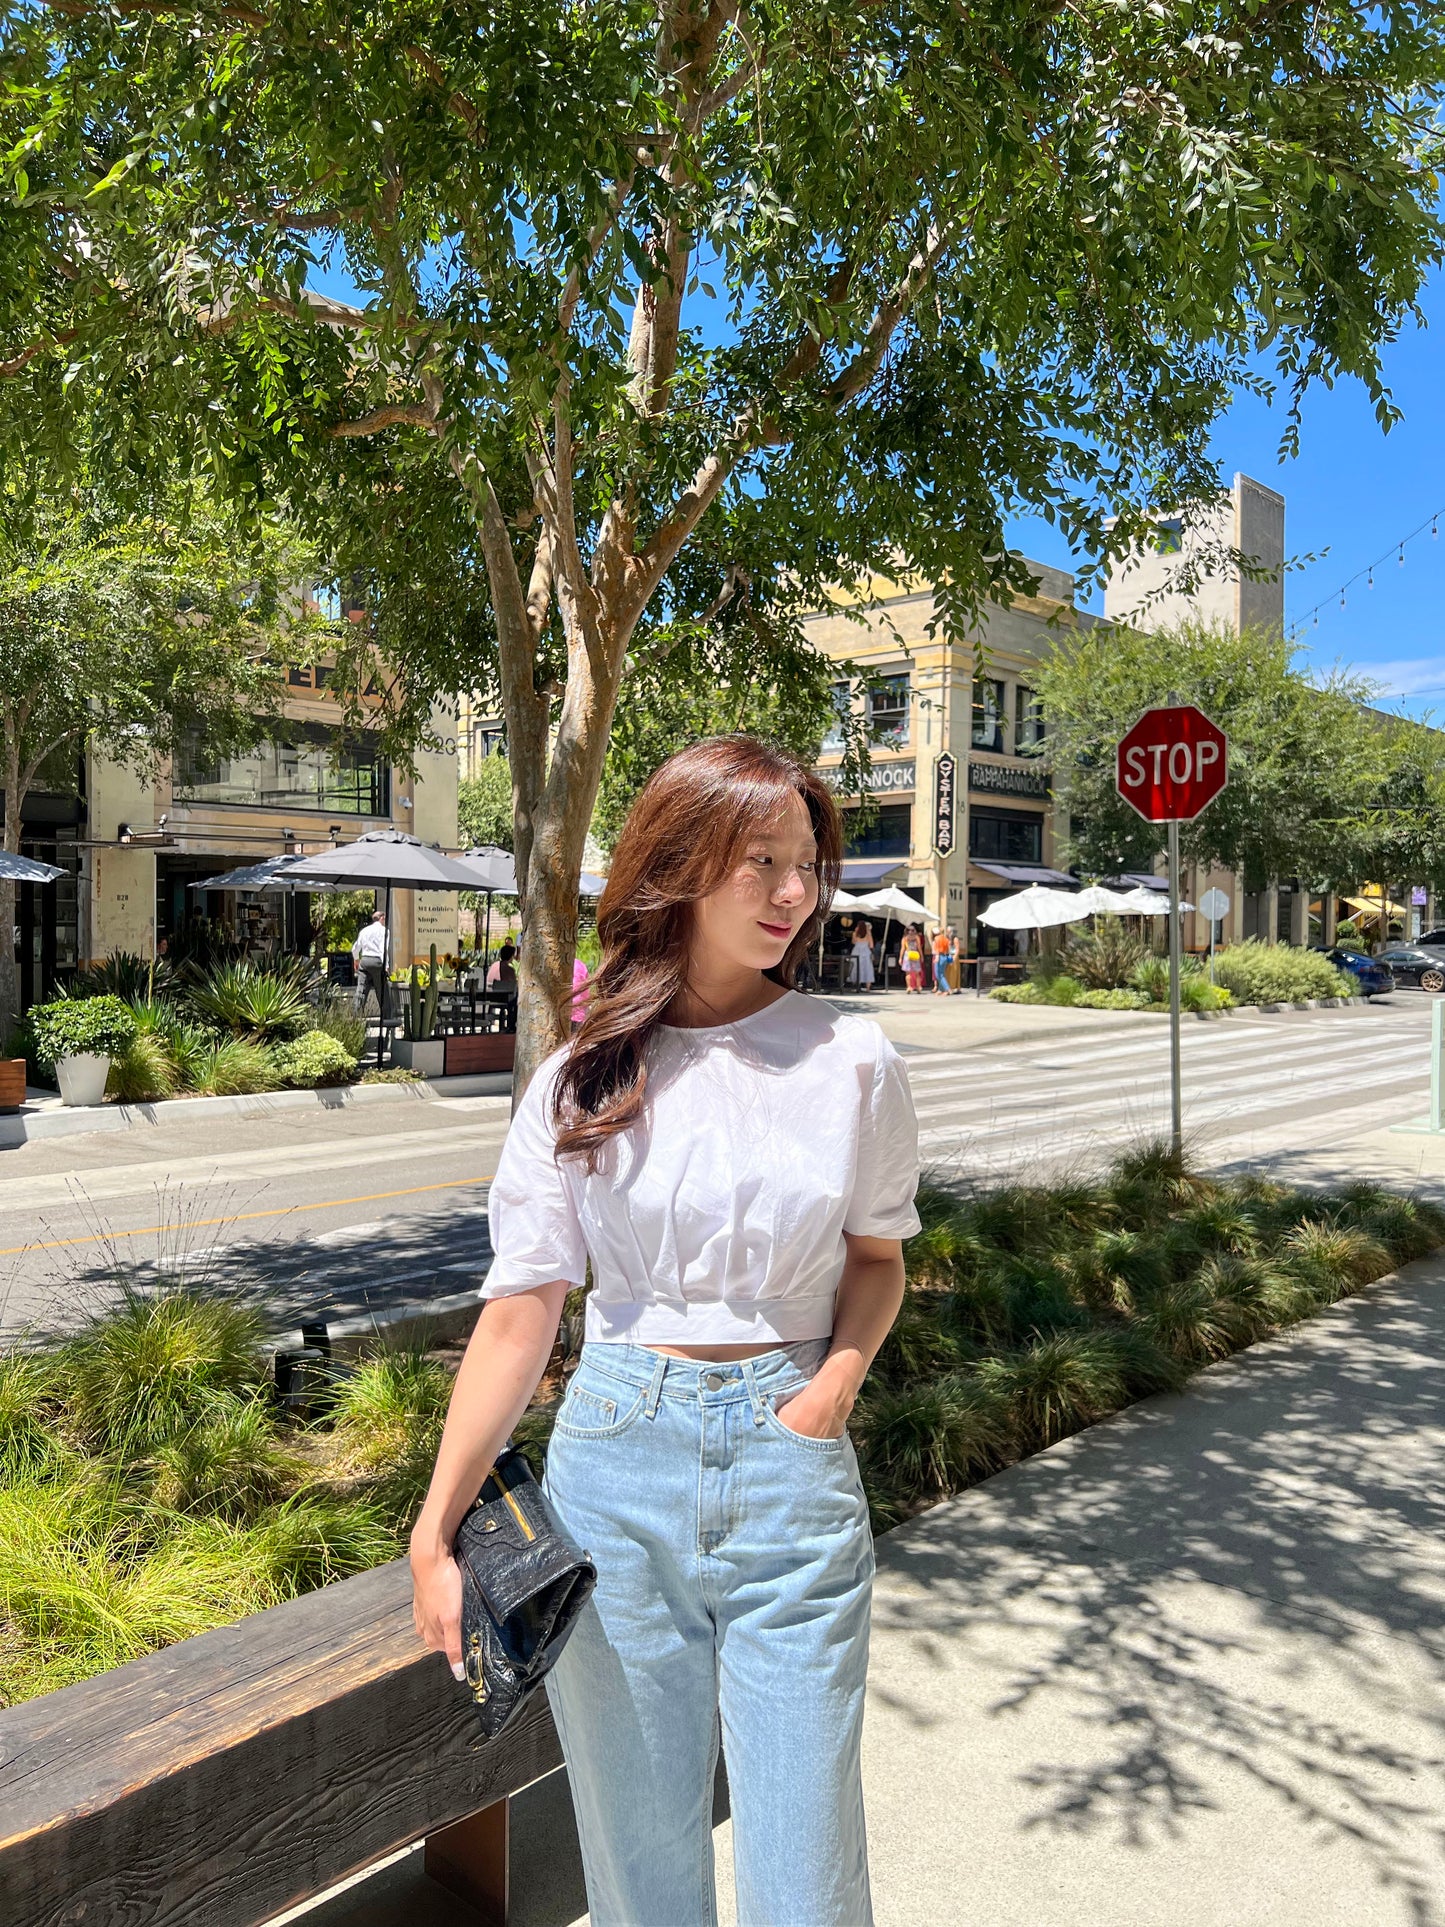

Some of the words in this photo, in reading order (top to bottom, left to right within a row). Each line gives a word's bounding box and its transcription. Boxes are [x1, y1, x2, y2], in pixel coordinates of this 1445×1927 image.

[972, 769, 1046, 794] RAPPAHANNOCK
[1124, 741, 1219, 787] STOP
[938, 760, 953, 816] OYSTER
[938, 819, 950, 848] BAR
